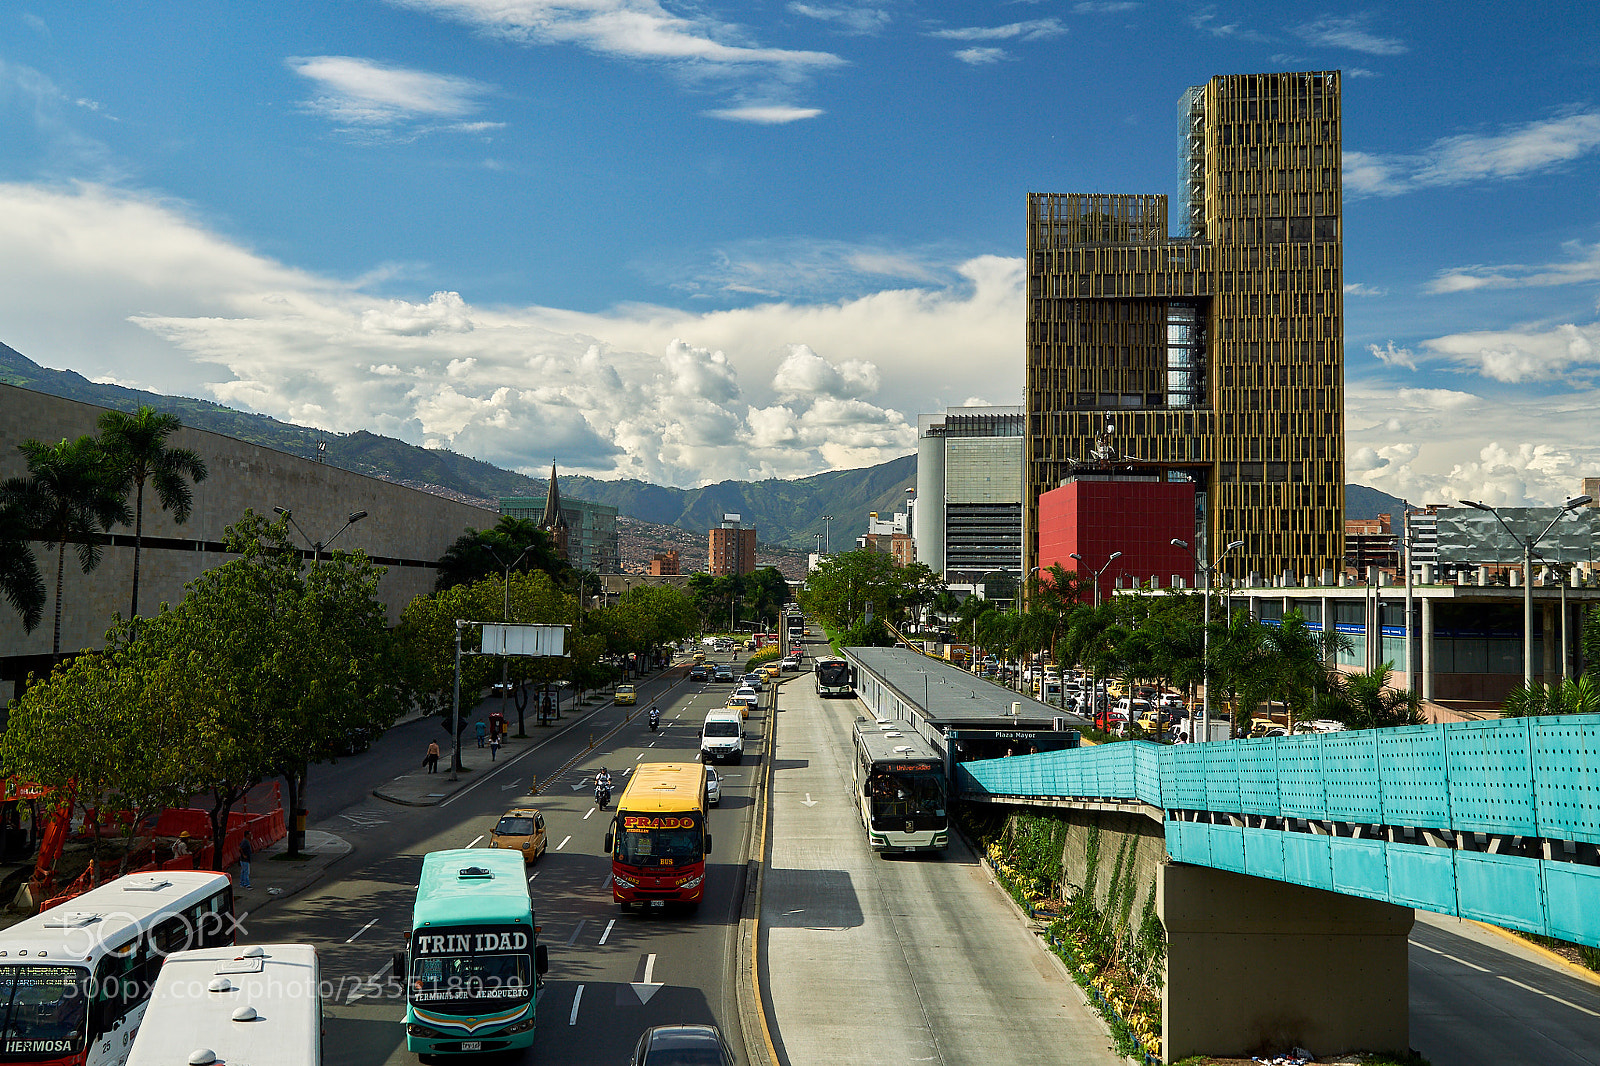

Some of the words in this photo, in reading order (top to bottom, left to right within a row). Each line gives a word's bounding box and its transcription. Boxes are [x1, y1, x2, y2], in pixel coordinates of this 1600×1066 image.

[624, 816, 695, 829] PRADO
[418, 932, 528, 954] TRINIDAD
[414, 992, 453, 1002] TERMINAL
[454, 991, 469, 1000] SUR
[475, 989, 529, 999] AEROPUERTO
[5, 1040, 72, 1052] HERMOSA
